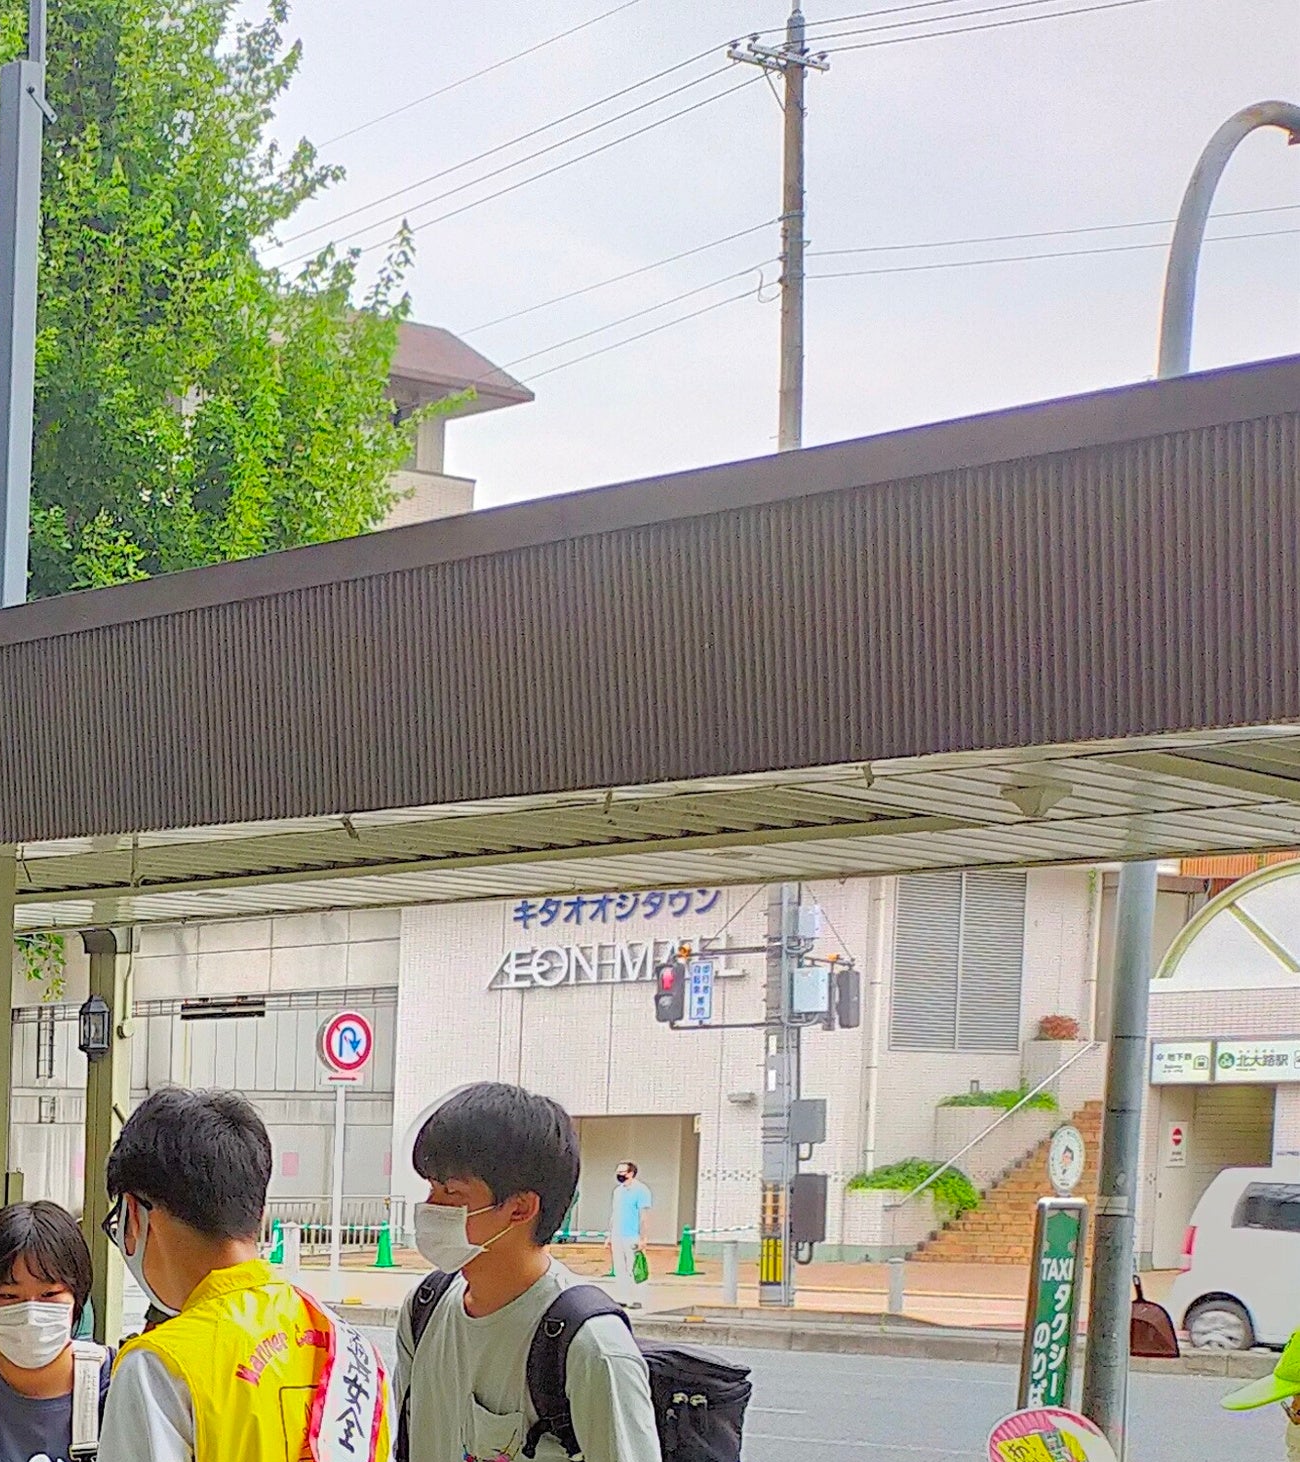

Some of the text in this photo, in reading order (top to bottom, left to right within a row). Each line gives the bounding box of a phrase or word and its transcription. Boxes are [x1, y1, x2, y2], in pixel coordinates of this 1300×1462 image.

[512, 889, 722, 929] キタオオジタウン
[613, 933, 747, 982] MAL
[1236, 1053, 1289, 1067] 北大路駅
[1040, 1257, 1074, 1282] TAXI
[236, 1332, 289, 1388] Manner
[1027, 1322, 1051, 1408] のりば
[1049, 1283, 1071, 1398] タクシー
